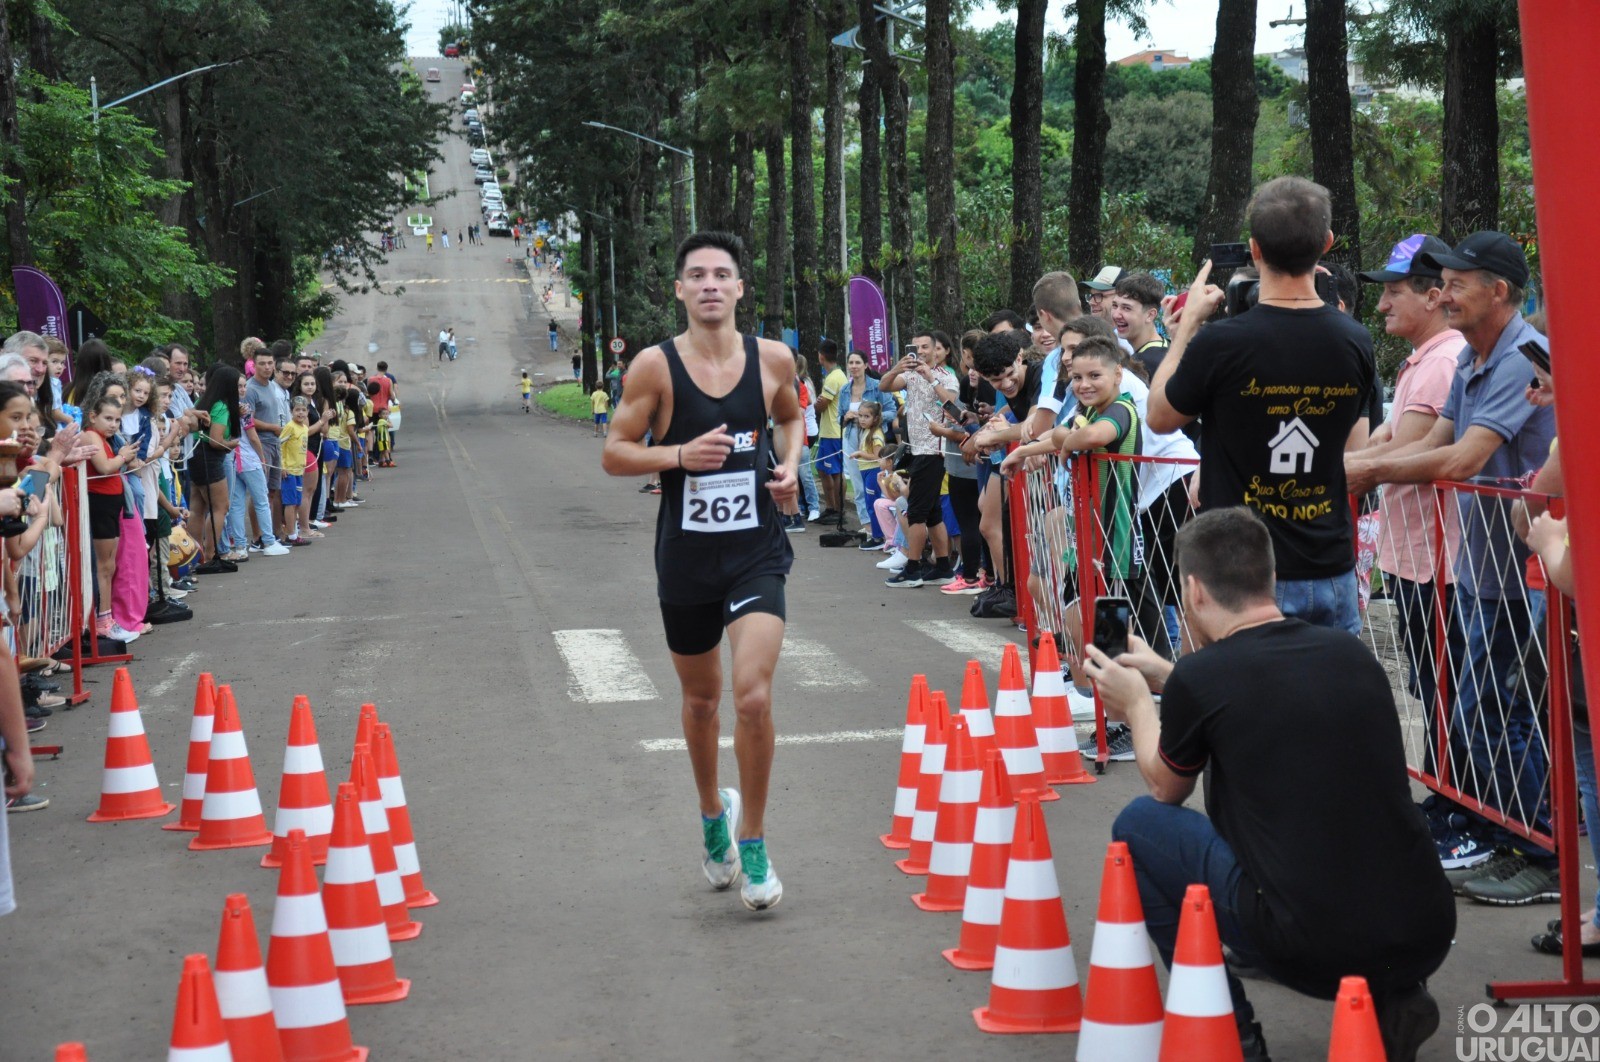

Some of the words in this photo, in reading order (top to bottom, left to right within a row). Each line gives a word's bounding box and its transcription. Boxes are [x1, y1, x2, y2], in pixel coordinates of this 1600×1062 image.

[873, 319, 882, 342] VINHO
[612, 341, 623, 349] 30
[869, 326, 878, 366] MARATONA
[876, 344, 884, 353] DO
[1262, 386, 1301, 397] pensou
[1303, 386, 1320, 395] em
[1267, 406, 1291, 415] uma
[1293, 397, 1336, 416] Casa?
[689, 494, 752, 524] 262
[1451, 840, 1477, 859] FILA
